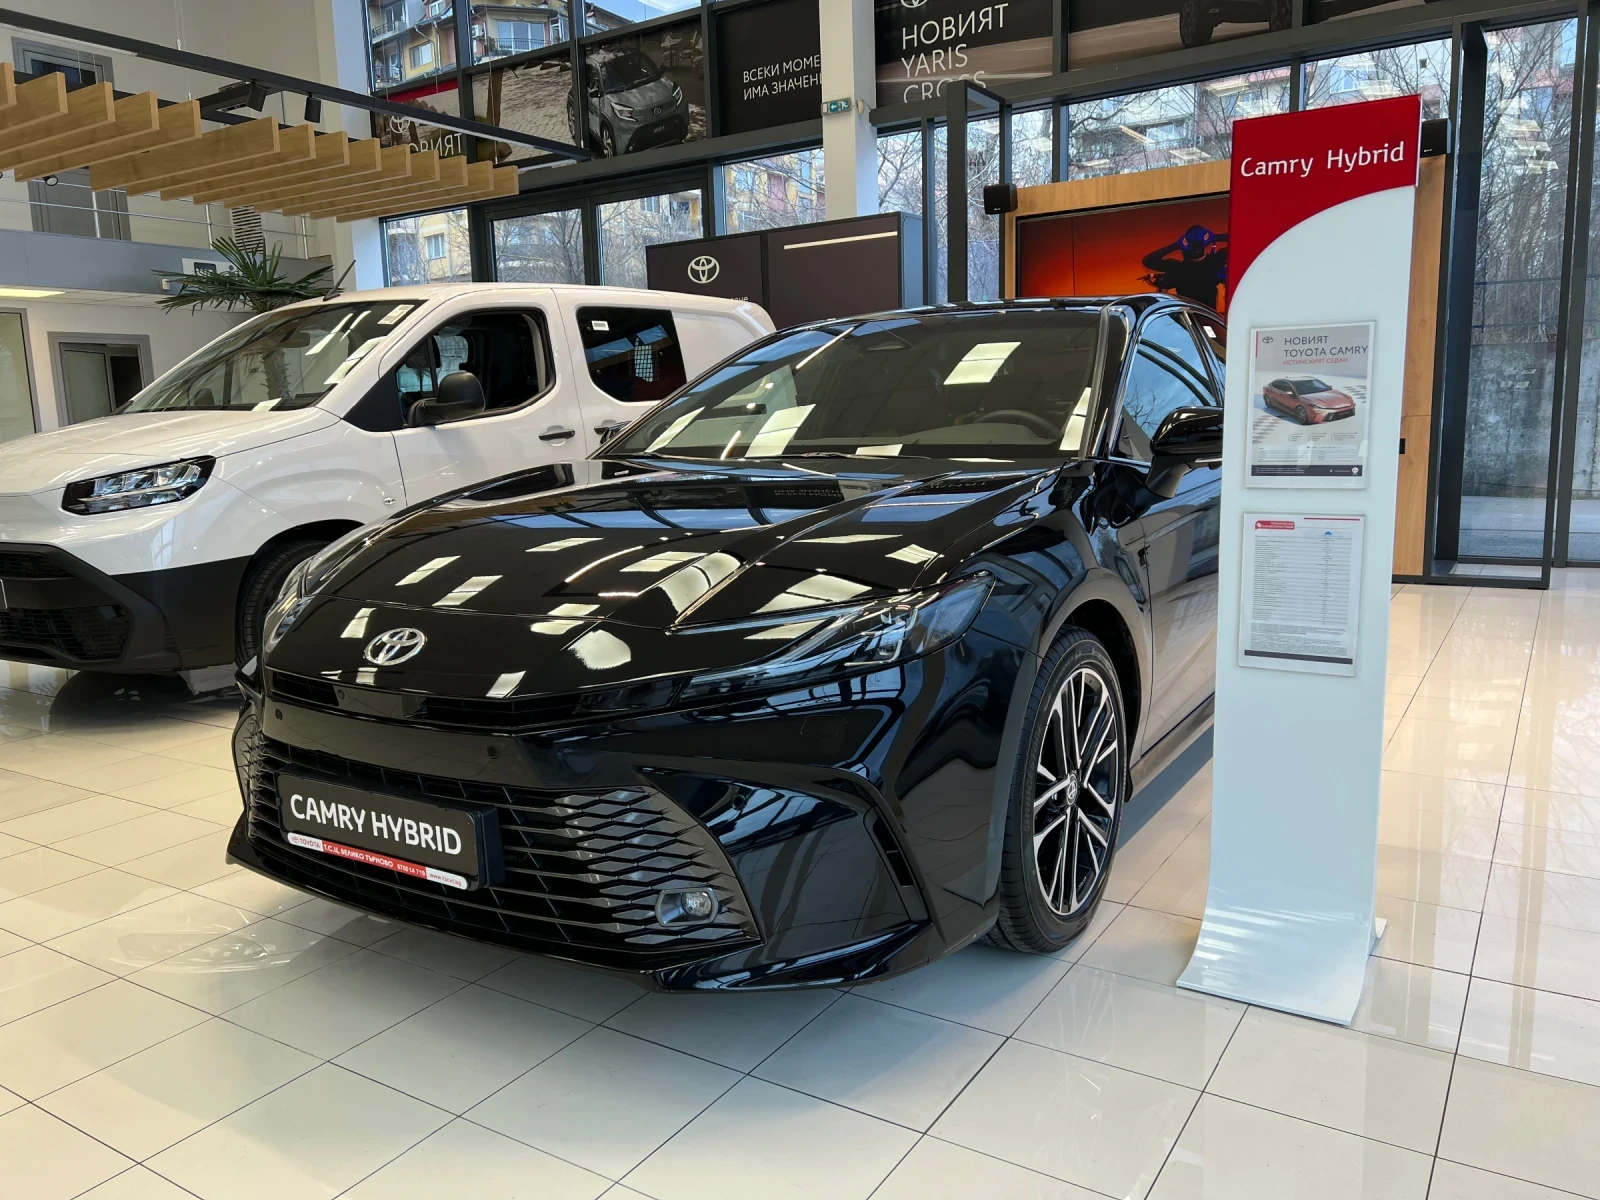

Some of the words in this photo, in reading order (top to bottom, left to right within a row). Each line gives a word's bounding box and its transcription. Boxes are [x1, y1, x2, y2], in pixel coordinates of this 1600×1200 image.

[902, 3, 1009, 50] НОВИЯТ
[743, 63, 780, 83] ВСЕКИ
[782, 54, 820, 74] МОМЕ
[901, 43, 968, 79] YARIS
[743, 84, 770, 101] ИМА
[771, 72, 822, 94] ЗНАЧЕН
[1240, 157, 1314, 178] Camry
[1327, 141, 1405, 173] Hybrid
[1284, 335, 1330, 346] НОВИЯТ
[1284, 347, 1327, 358] TOYOTA
[1329, 345, 1369, 356] CAMRY
[1283, 358, 1325, 366] ИСТИНСКИЯТ
[290, 794, 366, 833] CAMRY
[370, 811, 462, 855] HYBRID
[299, 837, 321, 849] TOYOTA
[340, 848, 365, 860] ВЕЛИКО
[365, 854, 394, 868] ТЪРНОВО
